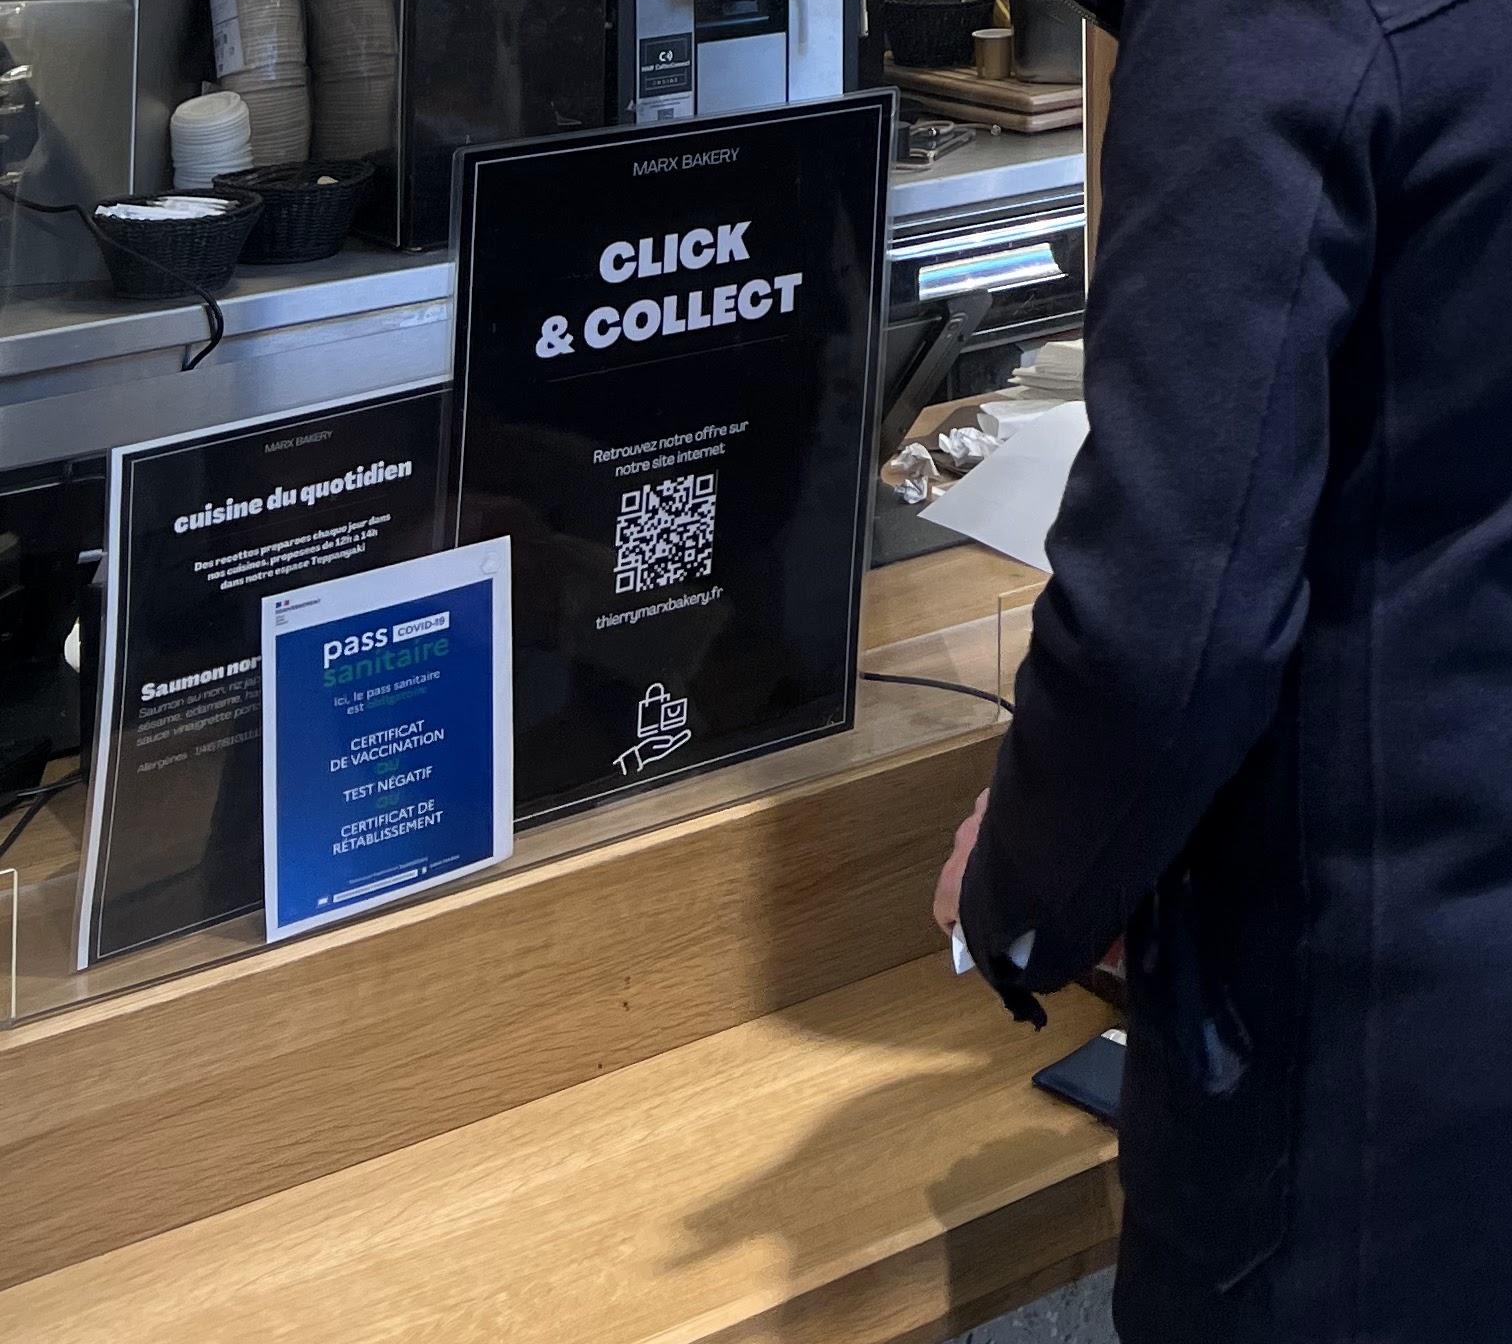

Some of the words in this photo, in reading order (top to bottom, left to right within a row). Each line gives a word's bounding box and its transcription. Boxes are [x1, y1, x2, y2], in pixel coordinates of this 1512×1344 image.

[633, 156, 678, 177] MARX
[681, 147, 740, 169] BAKERY
[599, 221, 752, 284] CLICK
[535, 315, 575, 359] &
[583, 272, 803, 349] COLLECT
[264, 436, 295, 454] MARX
[295, 430, 333, 447] BAKERY
[593, 440, 658, 464] Retrouvez
[659, 433, 694, 450] notre
[695, 425, 728, 441] offre
[729, 421, 749, 434] sur
[615, 460, 650, 478] notre
[651, 455, 676, 470] site
[677, 442, 726, 463] internet
[173, 497, 263, 534] cuisine
[266, 486, 297, 510] du
[300, 459, 413, 506] quotidien
[194, 560, 214, 572] Des
[215, 548, 260, 567] recettes
[312, 525, 347, 541] chaque
[347, 520, 368, 534] jour
[368, 513, 391, 526] dans
[207, 569, 226, 581] nos
[321, 540, 334, 550] de
[335, 535, 352, 547] 12h
[360, 528, 378, 540] 14h
[220, 577, 244, 590] dans
[245, 569, 274, 583] notre
[275, 560, 310, 577] espace
[311, 542, 366, 566] Teppanyaki
[595, 585, 724, 630] thierrymarxbakery.fr
[323, 627, 388, 669] pass
[397, 616, 446, 637] COVID-19
[323, 637, 449, 687] sanitaire
[140, 666, 225, 702] Saumon
[226, 655, 262, 676] nor
[333, 695, 351, 707] Ici,
[353, 691, 364, 702] le
[366, 684, 391, 701] pass
[393, 670, 441, 689] sanitaire
[346, 702, 365, 715] est
[330, 756, 348, 772] DE
[350, 728, 445, 766] VACCINATION
[350, 719, 425, 751] CERTIFICAT
[342, 783, 375, 802] TEST
[377, 766, 433, 793] NÉGATIF
[332, 810, 444, 856] RÉTABLISSEMENT
[340, 805, 415, 838] CERTIFICAT
[417, 799, 435, 814] DE
